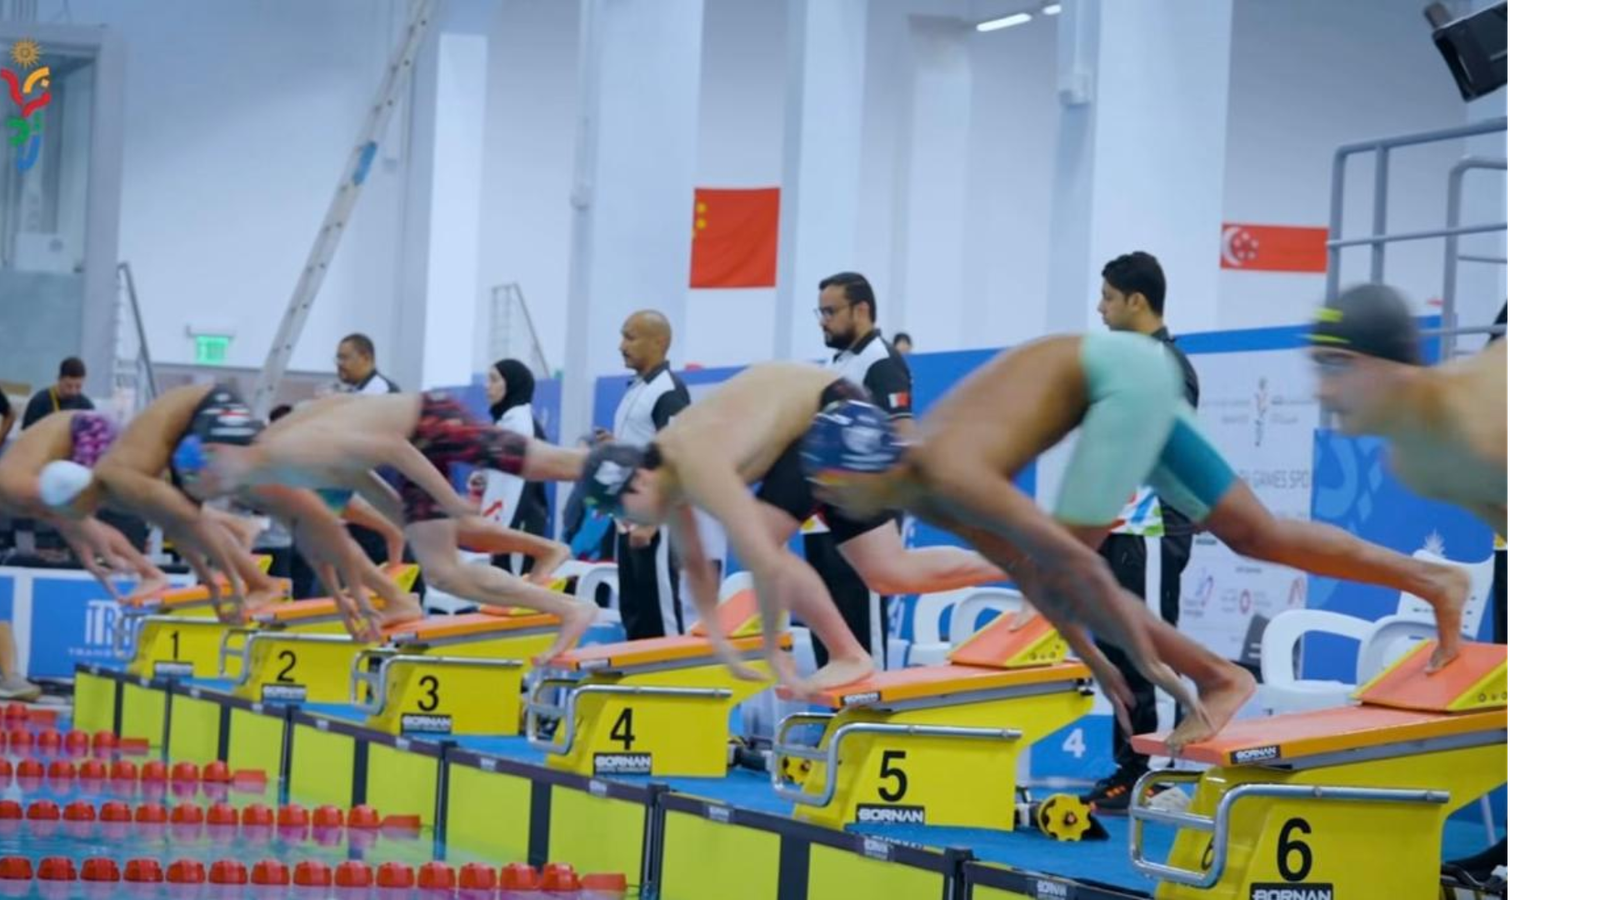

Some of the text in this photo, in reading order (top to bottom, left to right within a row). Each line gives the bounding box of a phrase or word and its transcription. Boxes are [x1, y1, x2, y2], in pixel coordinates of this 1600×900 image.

[170, 630, 179, 660] 1
[277, 650, 297, 682] 2
[417, 675, 439, 712] 3
[609, 707, 636, 750] 4
[1062, 728, 1086, 758] 4
[595, 755, 651, 768] BORNAN
[878, 750, 908, 802] 5
[858, 808, 923, 823] BORNAN
[1277, 817, 1312, 881] 6
[1252, 889, 1331, 900] BORNAN
